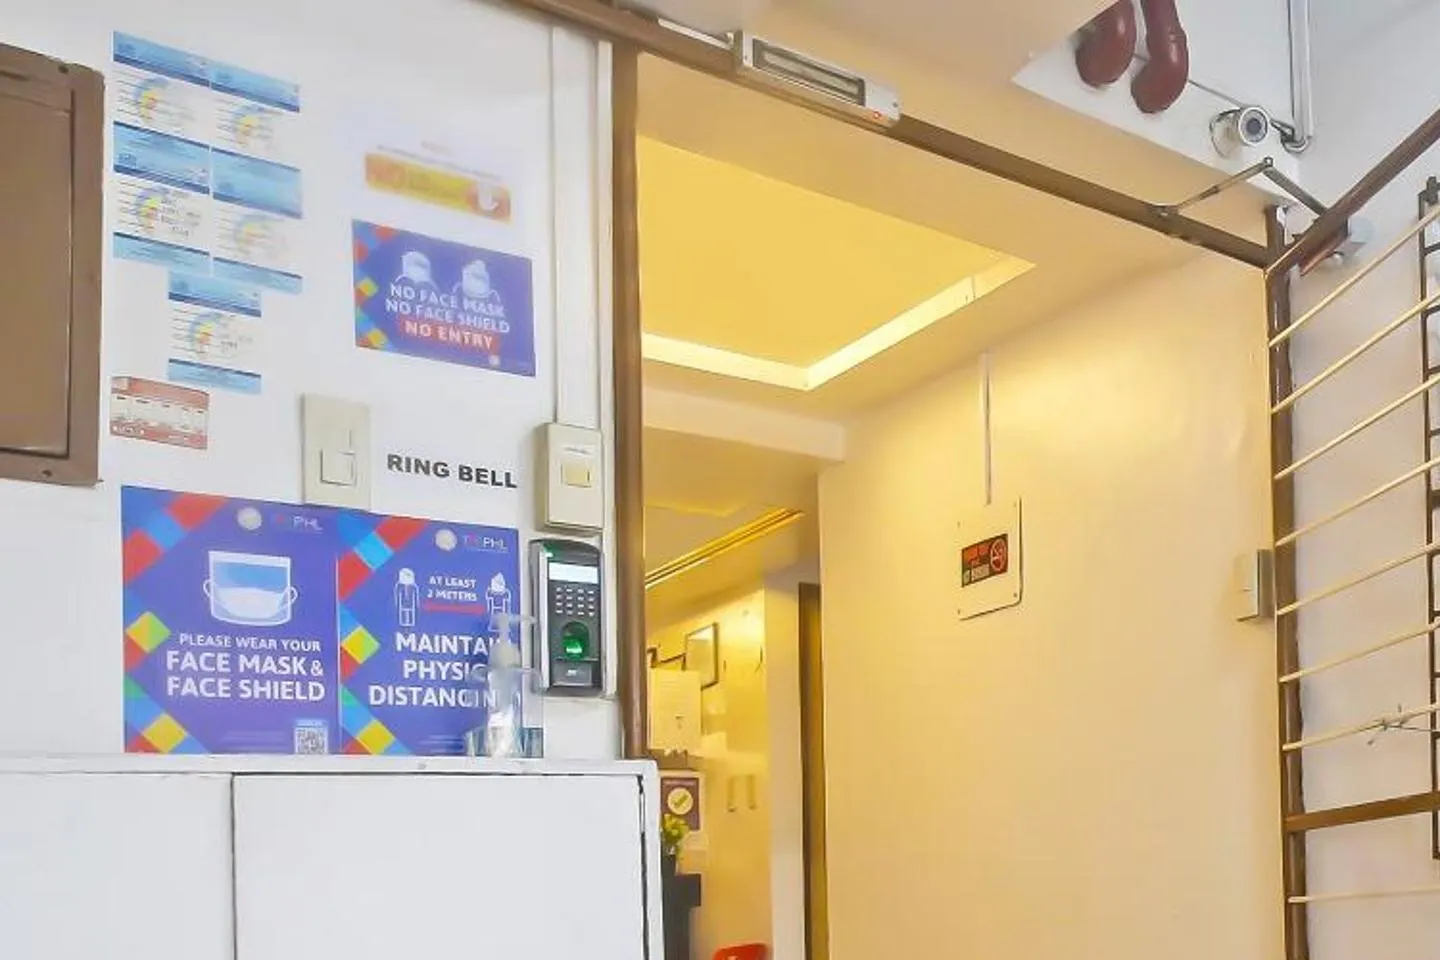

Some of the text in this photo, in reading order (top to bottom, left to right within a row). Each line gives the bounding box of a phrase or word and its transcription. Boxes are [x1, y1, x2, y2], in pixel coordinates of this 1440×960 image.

[390, 283, 506, 318] NO FACE MASK
[385, 298, 511, 334] NO FACE SHIELD
[405, 320, 494, 349] NO ENTRY
[387, 453, 518, 489] RING BELL
[429, 575, 477, 589] AT LEAST
[437, 589, 478, 602] METERS
[179, 633, 321, 652] PLEASE WEAR YOUR
[395, 632, 512, 657] MAINTA
[167, 651, 324, 677] FACE MASK &
[167, 677, 326, 701] FACE SHIELD
